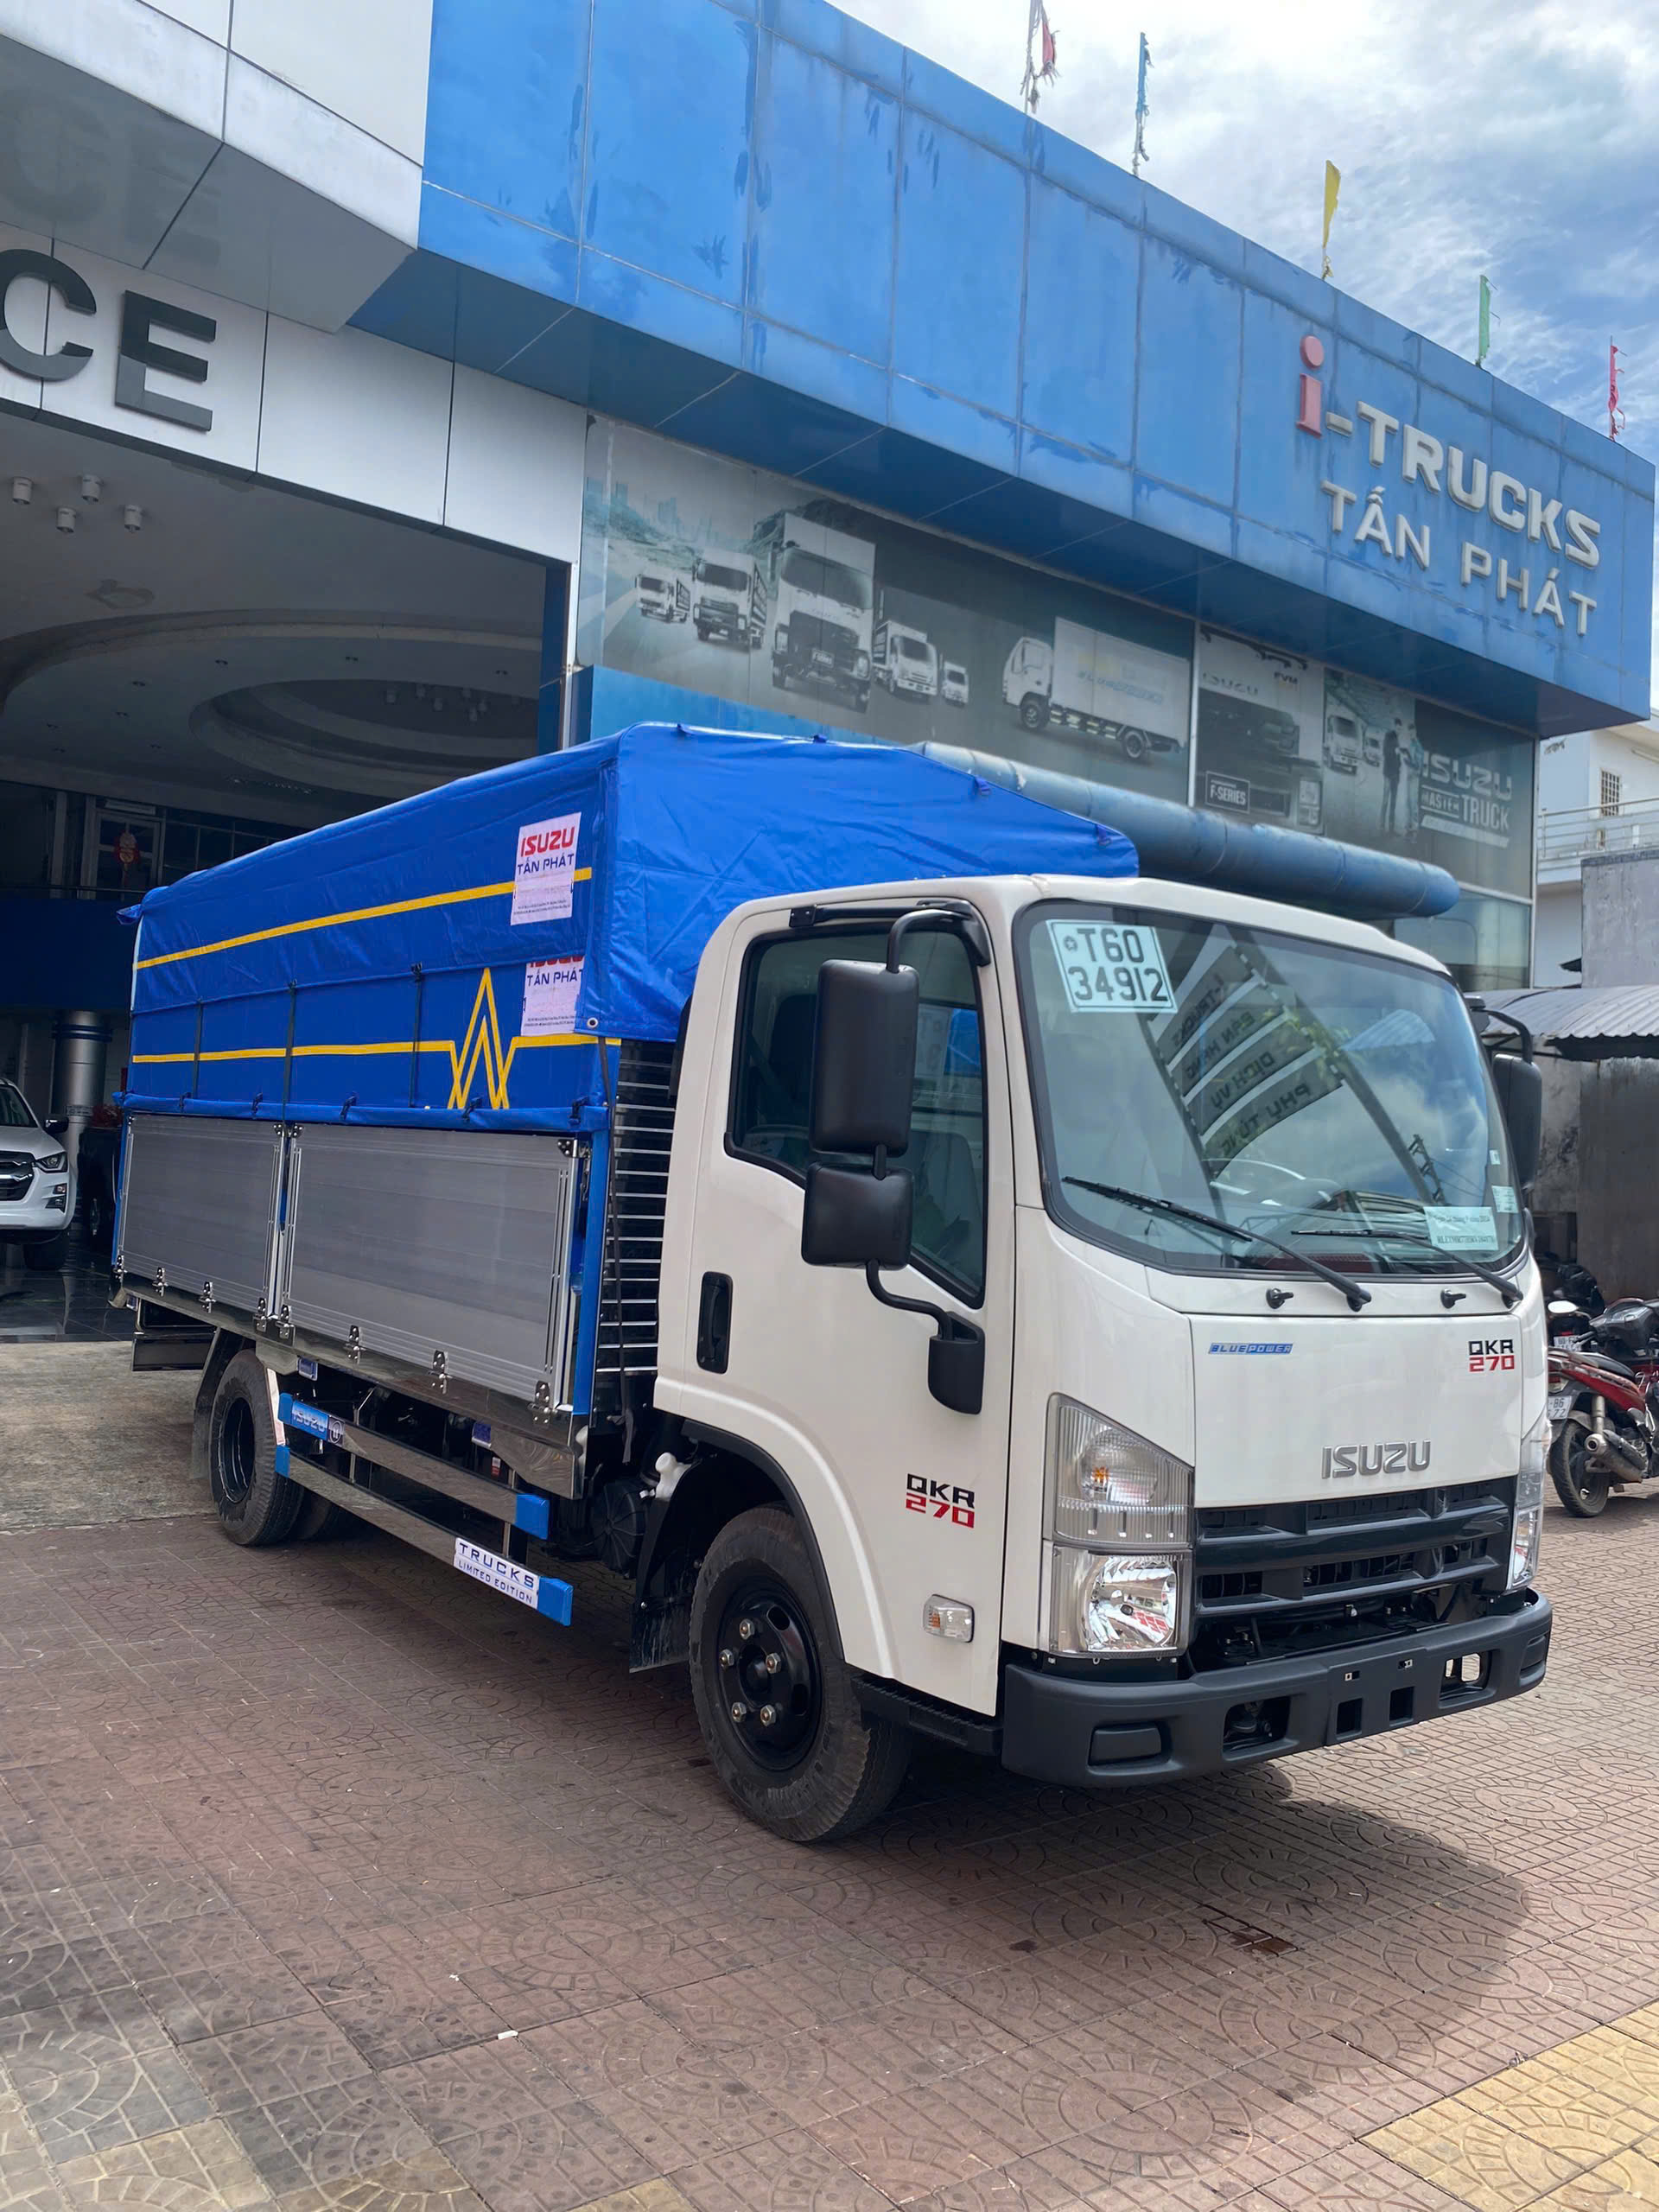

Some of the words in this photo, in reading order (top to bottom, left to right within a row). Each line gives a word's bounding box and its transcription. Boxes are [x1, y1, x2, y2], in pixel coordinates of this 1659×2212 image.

[1296, 335, 1601, 569] i-TRUCKS
[1320, 480, 1430, 570] TẤN
[1460, 542, 1598, 637] PHÁT
[1422, 750, 1512, 801] ISUZU
[1210, 785, 1246, 805] F-SERIES
[1461, 794, 1510, 830] TRUCK
[521, 827, 575, 857] ISUZU
[518, 857, 540, 875] TẤN
[543, 853, 575, 870] PHÁT
[1077, 928, 1145, 963] T60
[527, 969, 550, 987] TẤN
[1068, 966, 1168, 1001] 34912
[1209, 1344, 1293, 1354] BLUEPOWER
[1468, 1339, 1514, 1355] QKR
[1469, 1355, 1515, 1372] 270
[294, 1409, 326, 1433] ISUZU
[1321, 1440, 1431, 1479] ISUZU
[906, 1473, 975, 1510] QKR
[906, 1492, 975, 1529] 270
[458, 1560, 491, 1582] LIMITED
[494, 1579, 532, 1604] EDITION
[460, 1542, 534, 1588] TRUCKS
